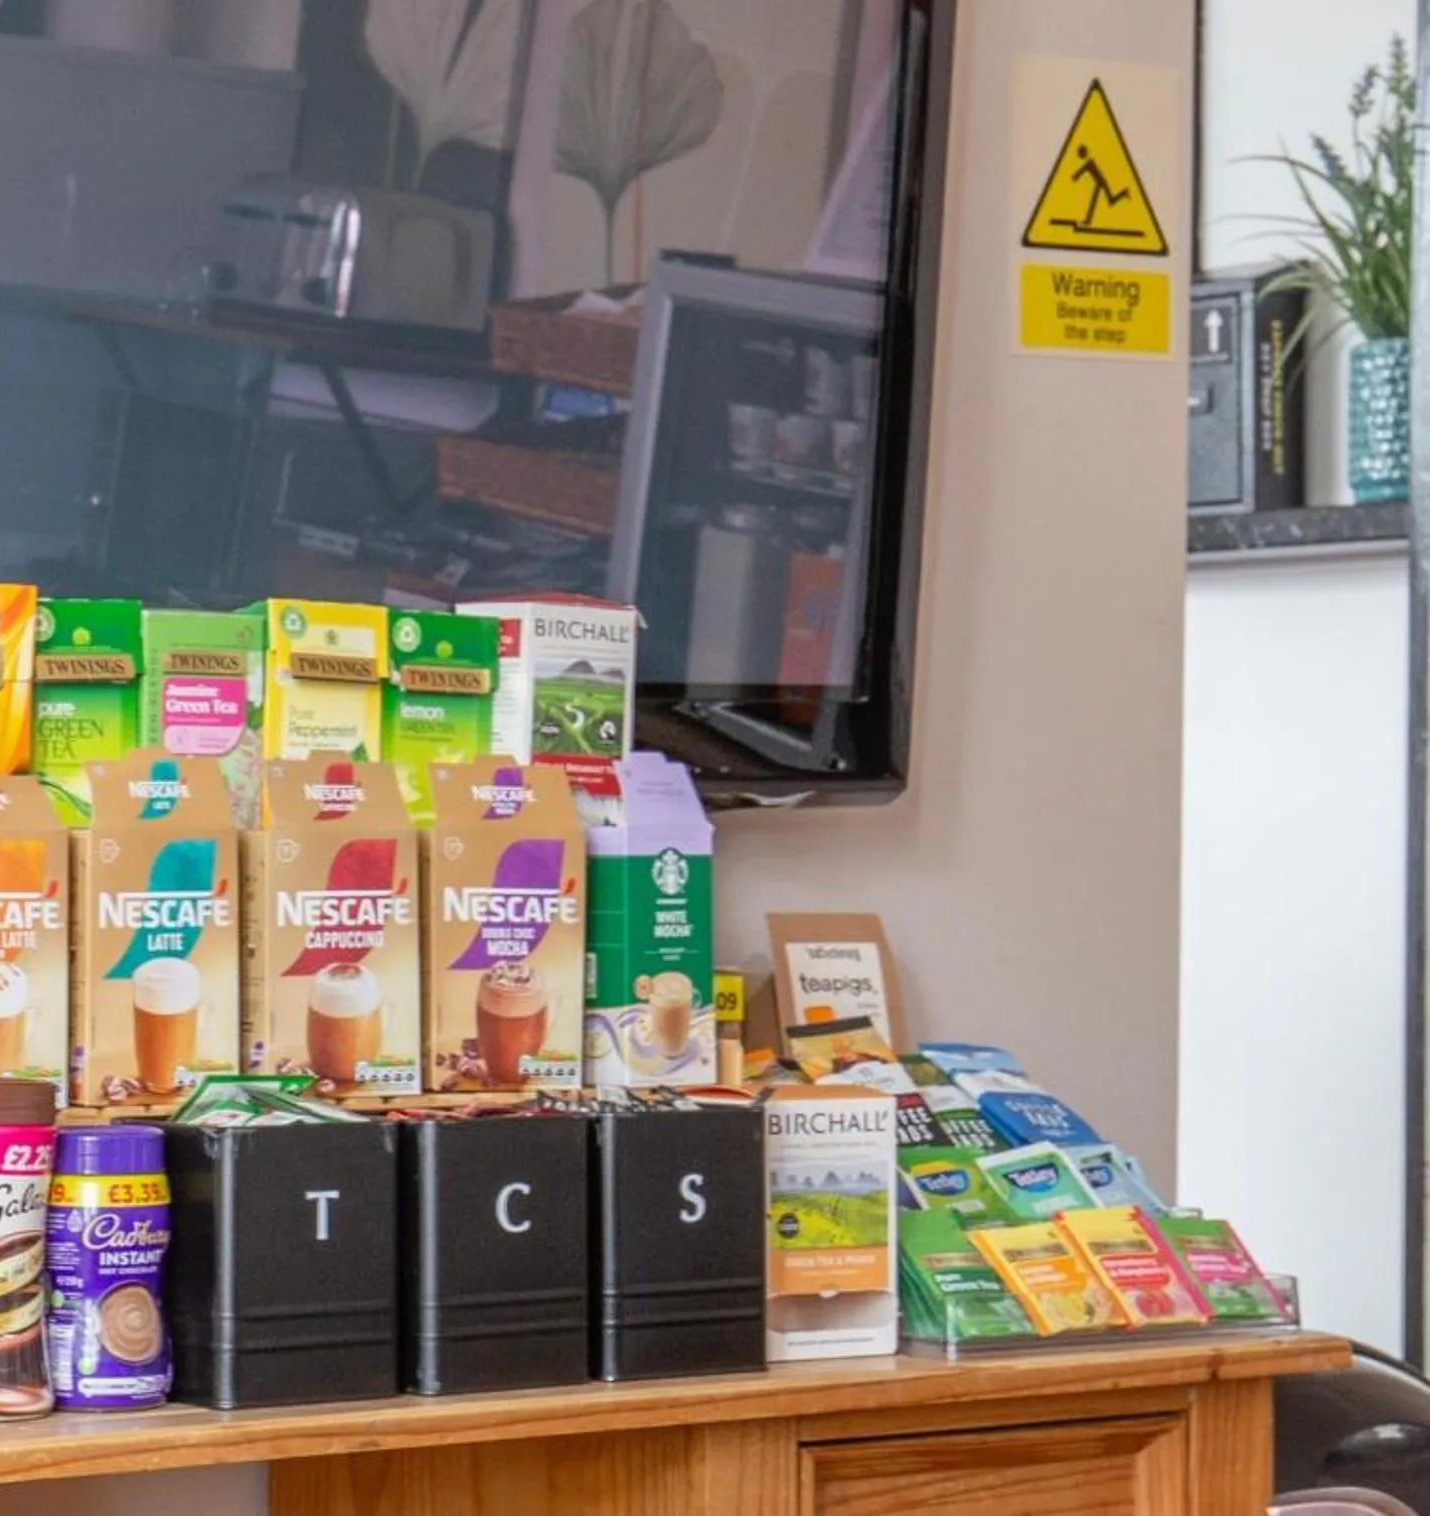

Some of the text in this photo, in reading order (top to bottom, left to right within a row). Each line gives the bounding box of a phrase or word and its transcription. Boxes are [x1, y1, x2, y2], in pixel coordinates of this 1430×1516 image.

[1051, 272, 1140, 308] Warning
[1056, 301, 1134, 323] Beware of
[1064, 323, 1128, 347] the step
[534, 617, 630, 644] BIRCHALL
[46, 658, 125, 676] TWININGS
[170, 654, 239, 671] TWININGS
[297, 657, 371, 678] TWININGS
[407, 668, 482, 689] TWININGS
[37, 702, 76, 718] pure
[400, 701, 445, 718] lemon
[38, 718, 105, 739] GREEN
[38, 738, 78, 759] TEA
[653, 910, 688, 924] WHITE
[1, 930, 38, 950] LATTE
[147, 932, 185, 951] LATTE
[304, 930, 386, 950] CAPPUCCINO
[486, 940, 529, 957] MOCHA
[768, 1110, 889, 1136] BIRCHALL
[1006, 1164, 1058, 1187] Tetley
[495, 1182, 533, 1233] C
[679, 1173, 707, 1223] S
[305, 1189, 340, 1241] T
[82, 1212, 171, 1251] Cadbury
[98, 1249, 165, 1266] INSTANT
